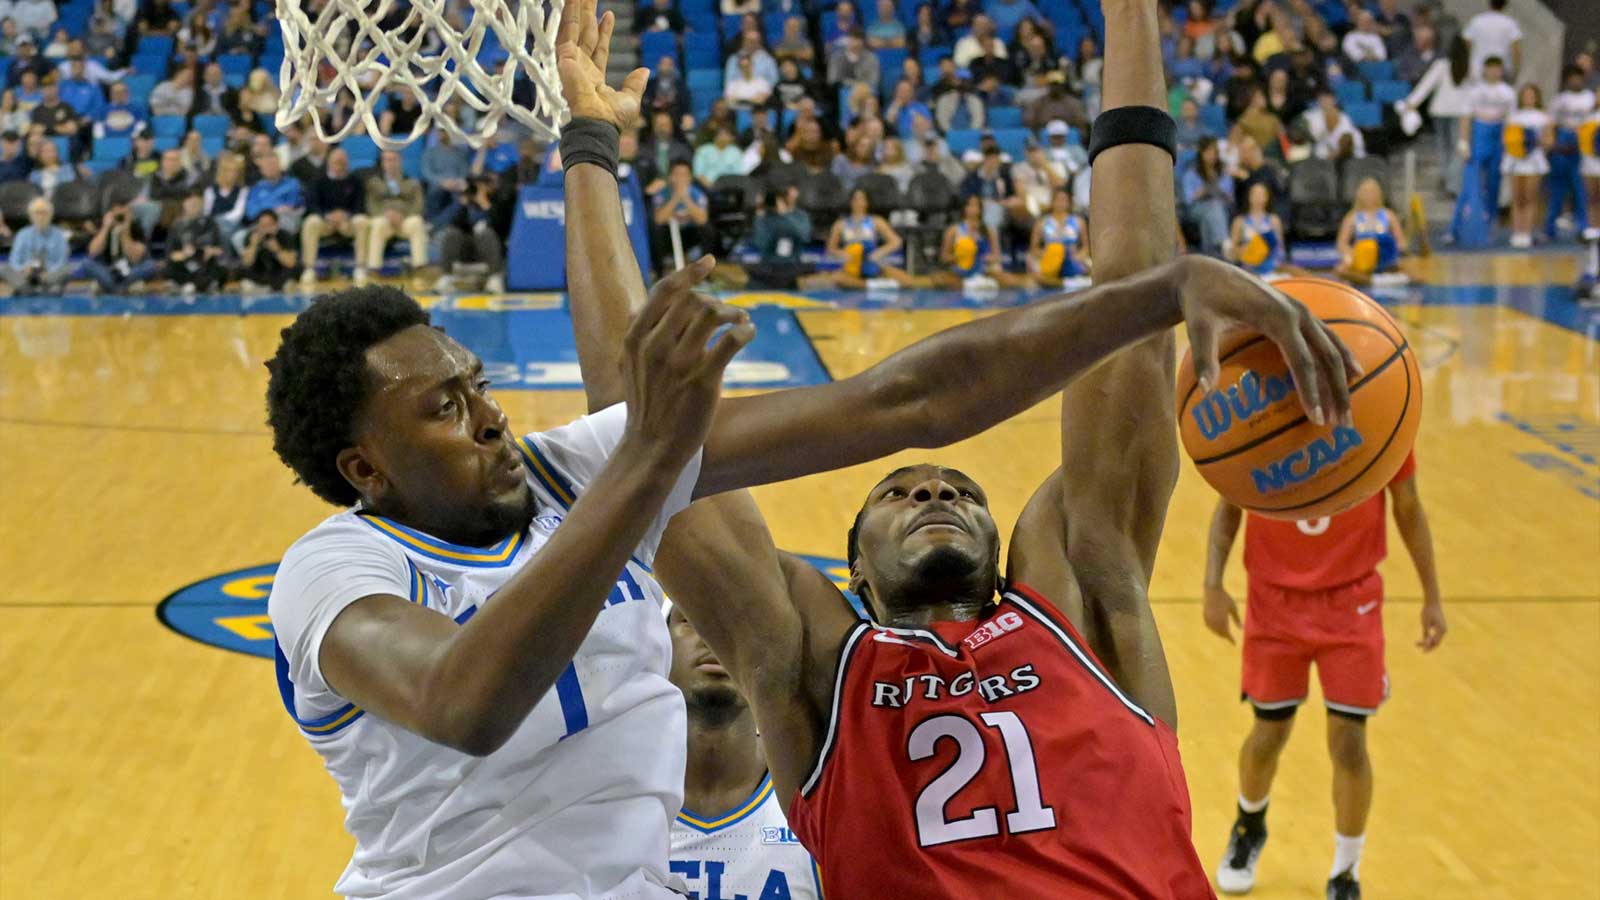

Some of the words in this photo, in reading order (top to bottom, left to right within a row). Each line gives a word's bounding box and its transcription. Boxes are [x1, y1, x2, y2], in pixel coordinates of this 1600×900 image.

[1191, 369, 1296, 441] Wils
[1250, 426, 1364, 495] NCAA
[907, 710, 1057, 848] 21
